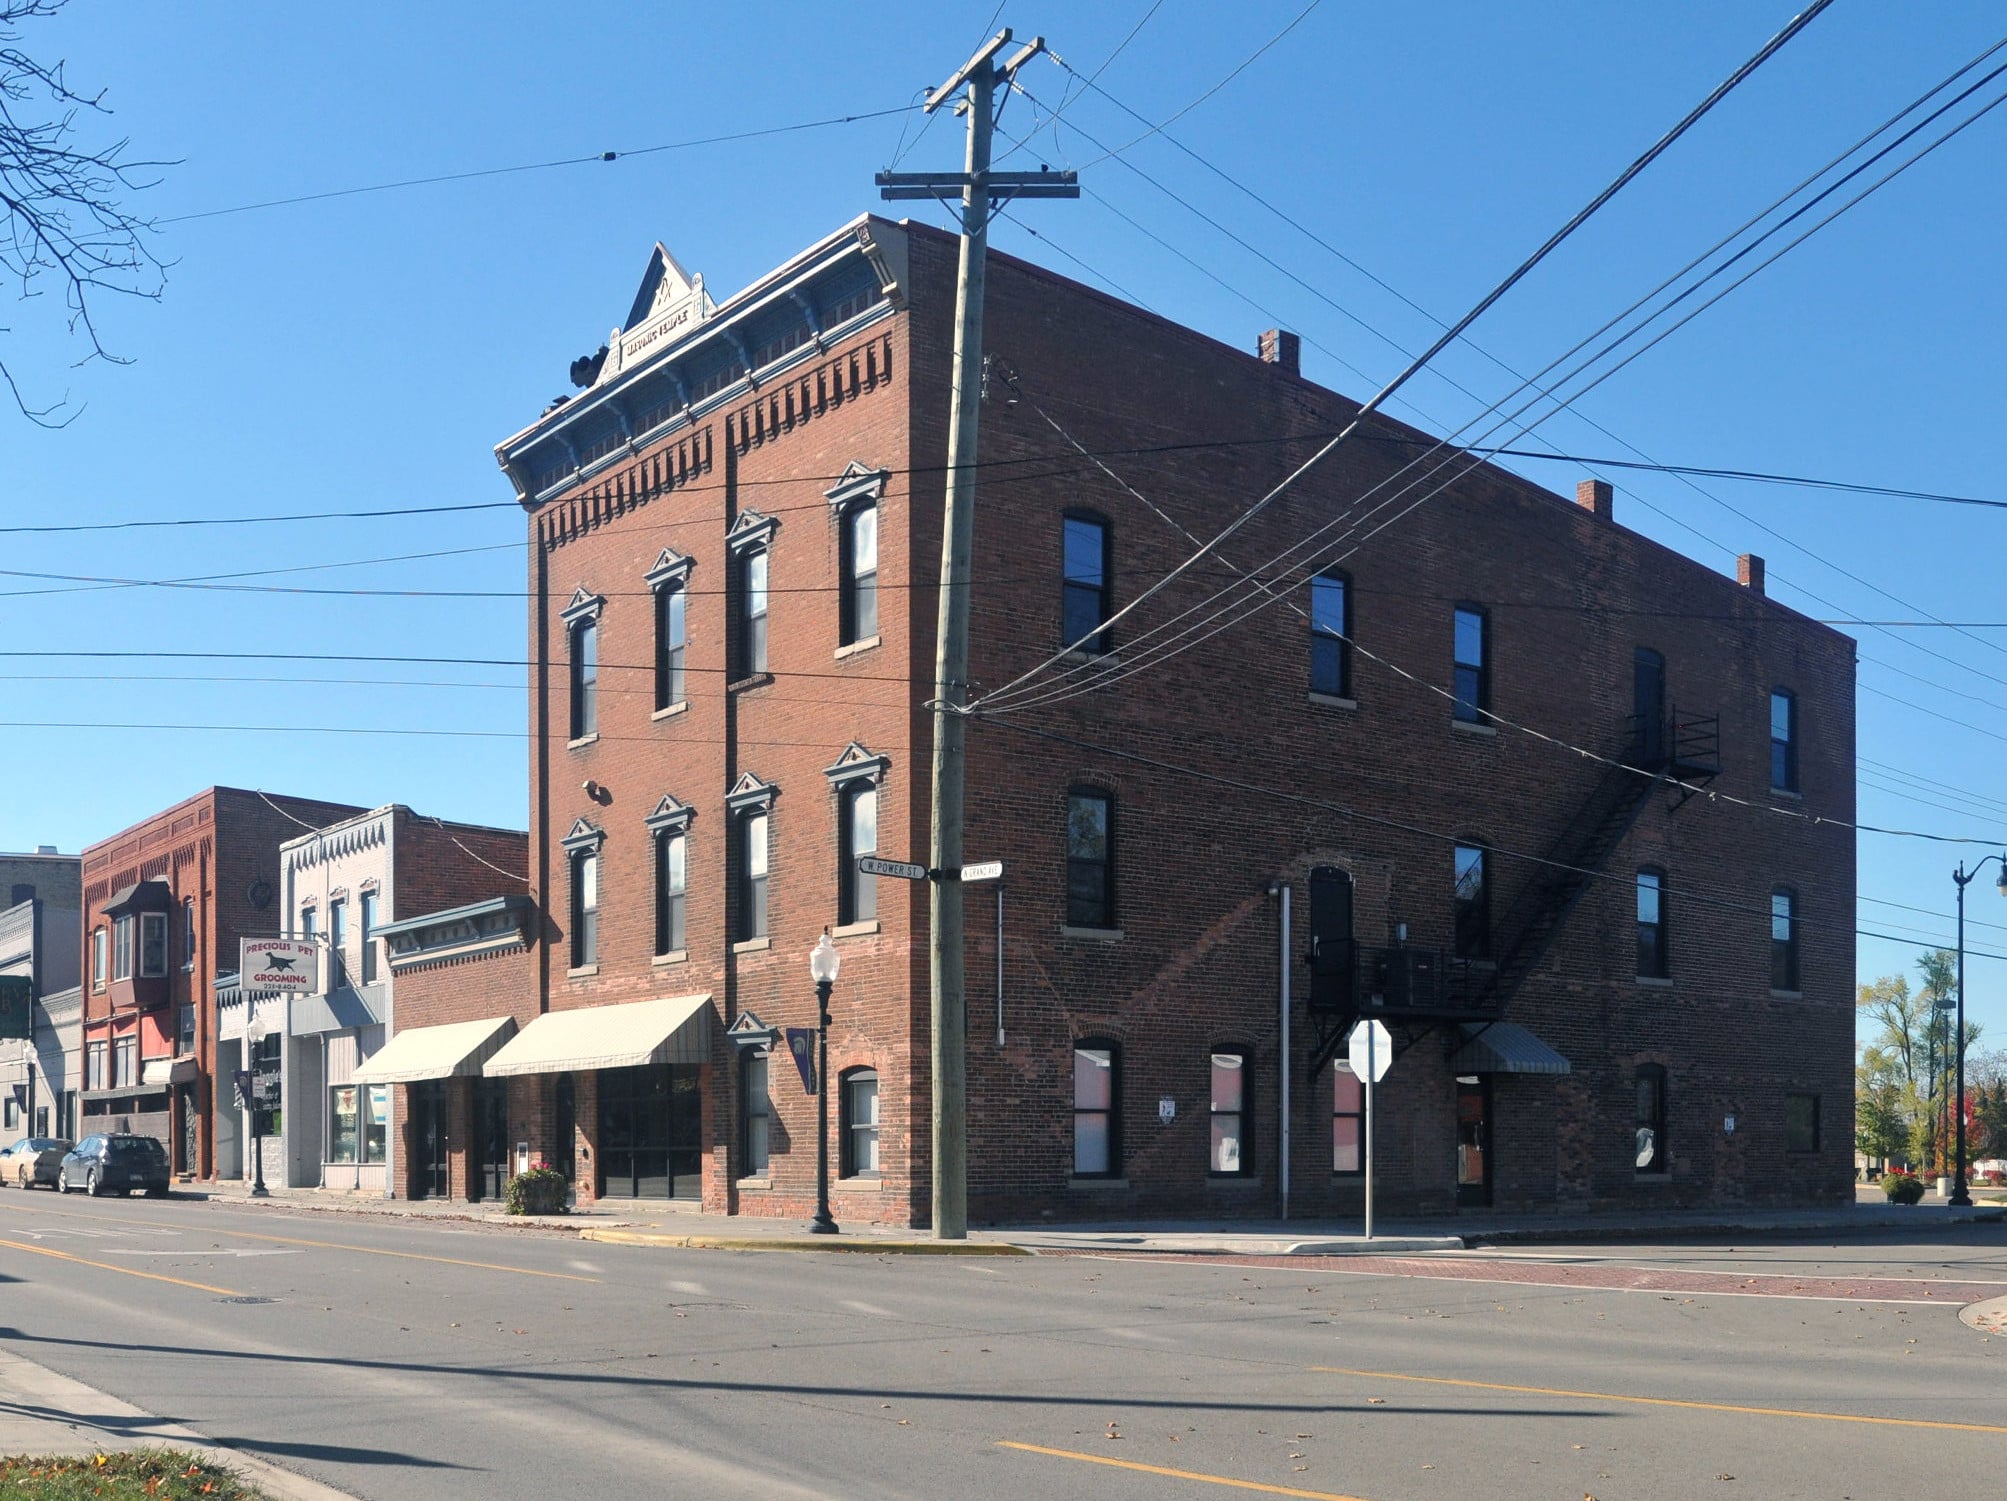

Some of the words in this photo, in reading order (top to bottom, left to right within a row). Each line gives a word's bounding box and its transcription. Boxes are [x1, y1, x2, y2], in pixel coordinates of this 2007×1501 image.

[659, 309, 688, 336] TEMPLE
[877, 862, 905, 875] POWER
[907, 866, 918, 877] ST
[246, 942, 291, 954] PRECIOUS
[297, 945, 313, 957] PET
[253, 973, 307, 984] GROOMING
